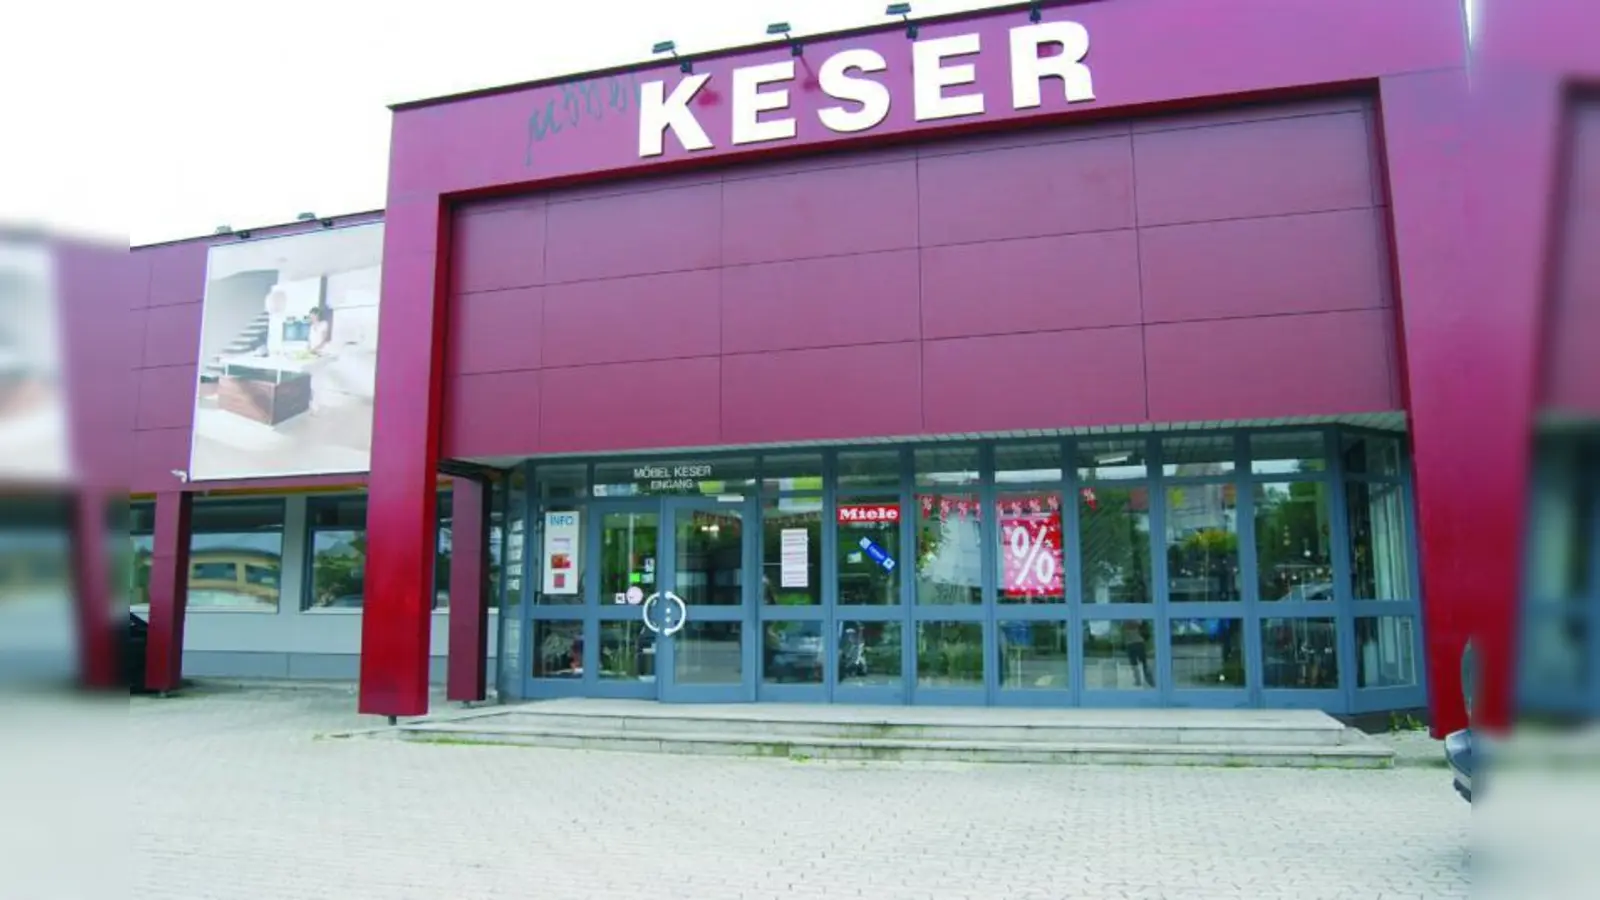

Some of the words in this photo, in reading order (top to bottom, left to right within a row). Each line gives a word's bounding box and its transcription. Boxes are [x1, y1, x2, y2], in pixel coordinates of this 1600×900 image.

[638, 20, 1096, 157] KESER
[634, 464, 671, 478] MÖBEL
[674, 464, 711, 477] KESER
[651, 479, 693, 490] EINGANG
[550, 514, 573, 526] INFO
[840, 506, 898, 521] Miele
[1010, 525, 1056, 585] %
